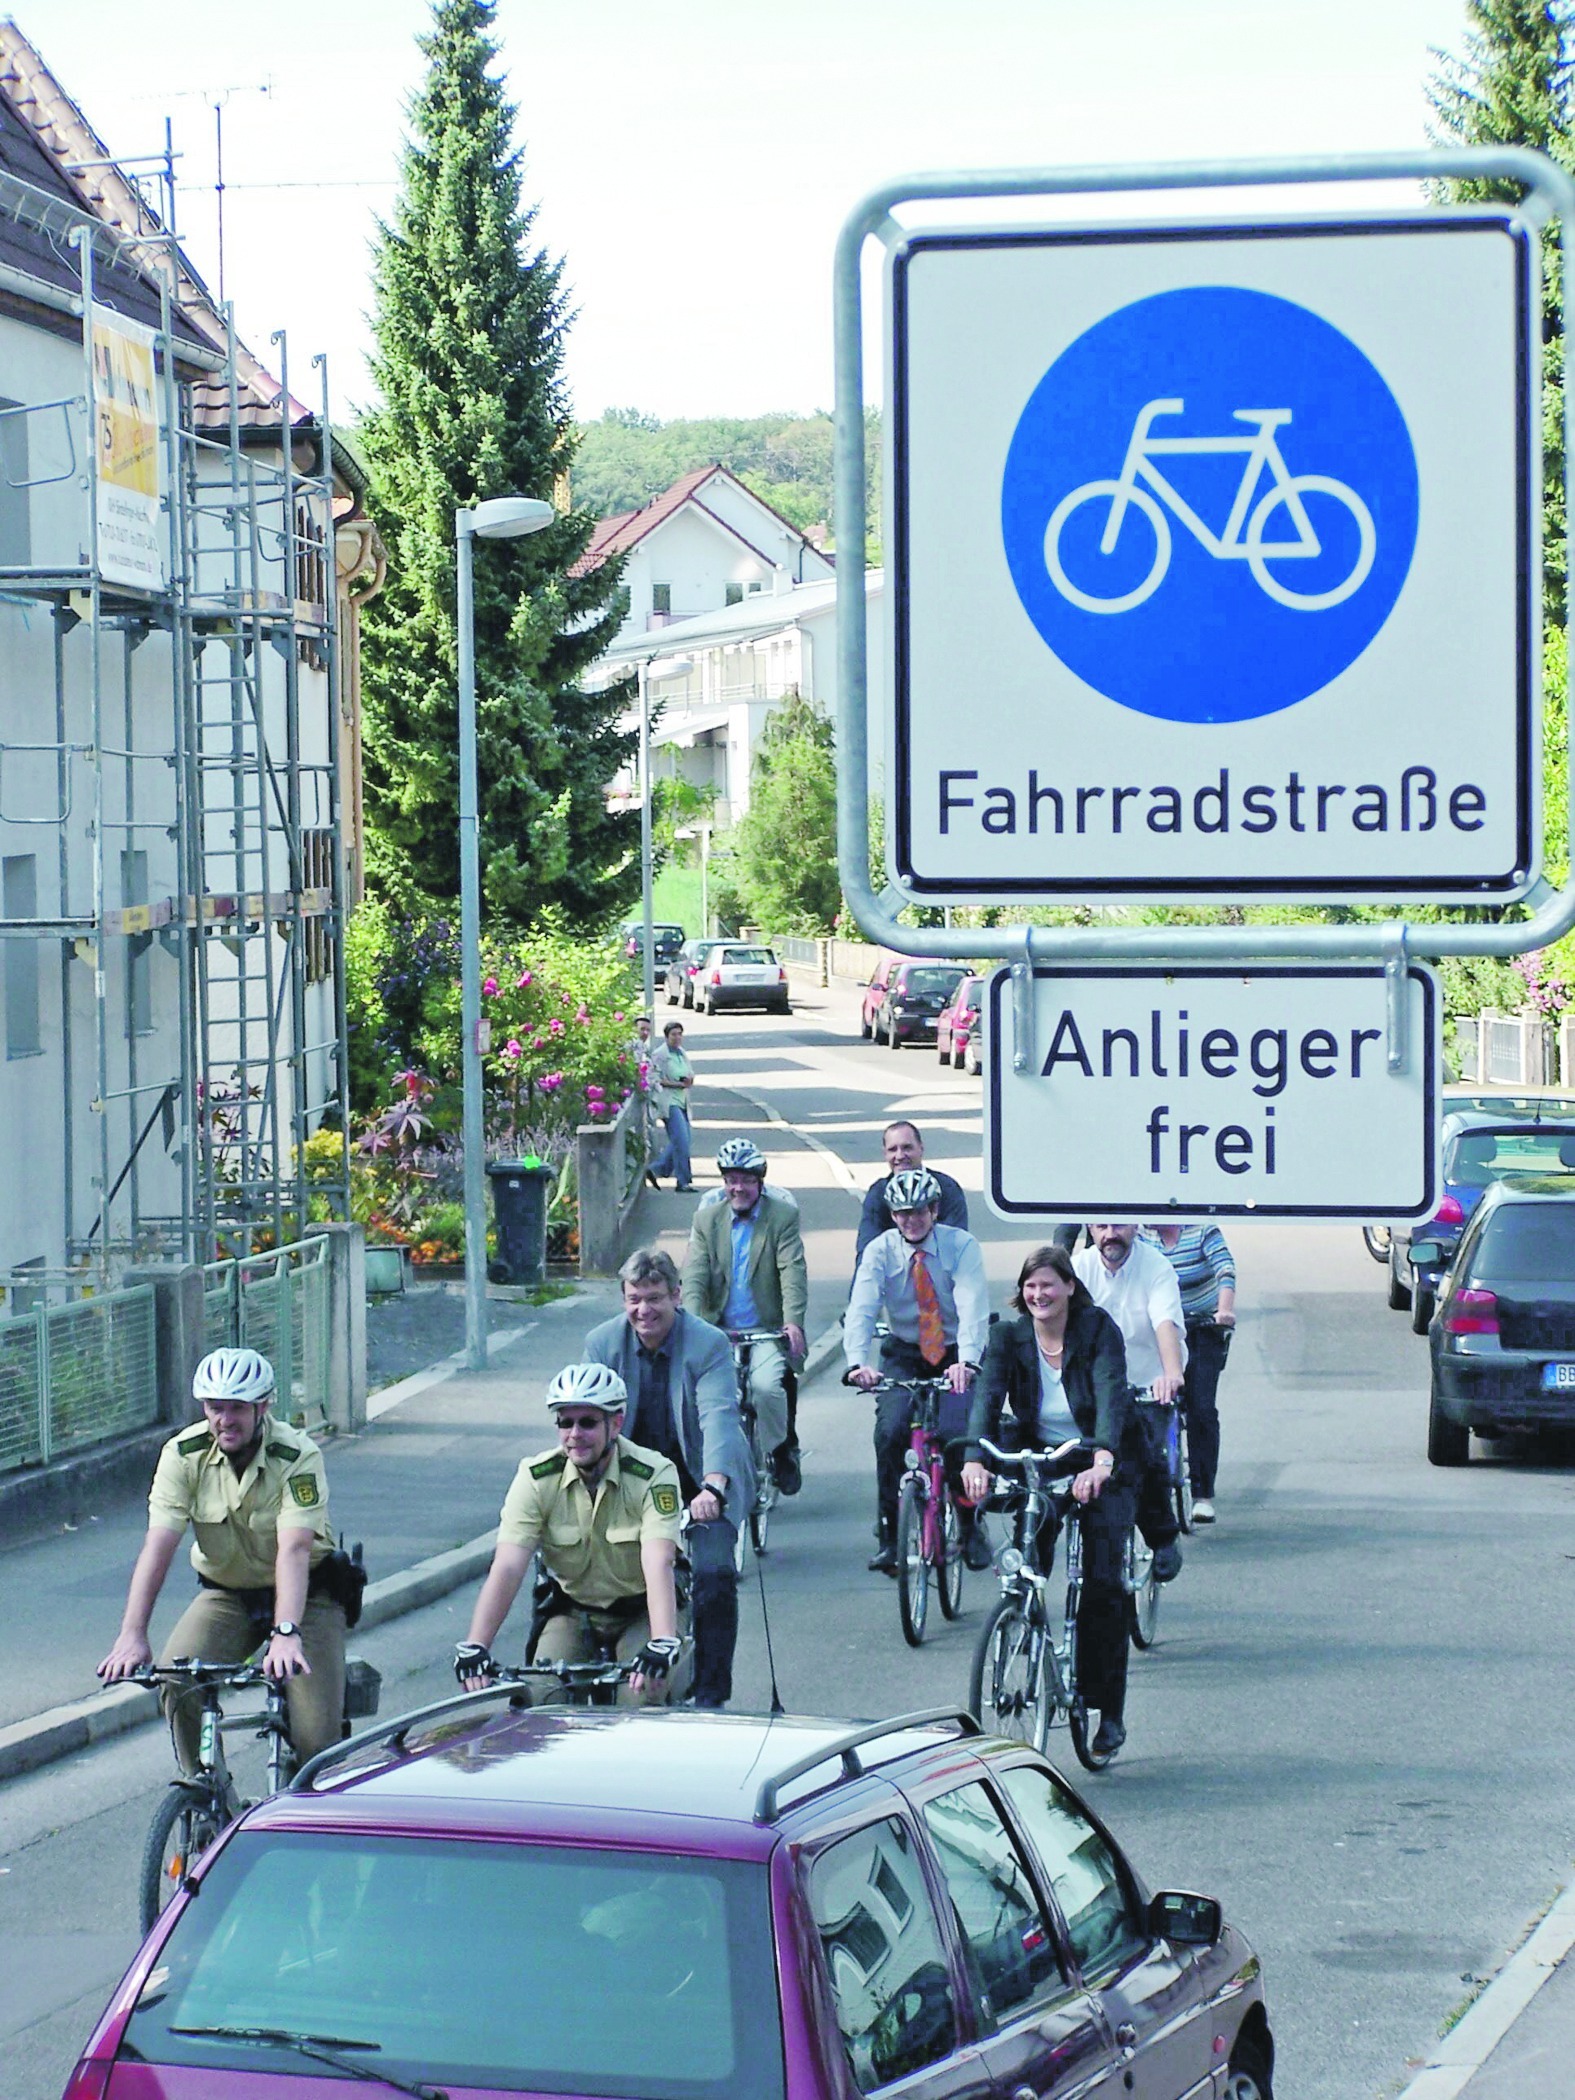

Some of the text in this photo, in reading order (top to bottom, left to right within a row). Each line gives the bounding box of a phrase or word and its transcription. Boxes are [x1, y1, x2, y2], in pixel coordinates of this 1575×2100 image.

[939, 765, 1487, 835] Fahrradstraße
[1040, 1010, 1382, 1098] Anlieger
[1146, 1105, 1276, 1175] frei
